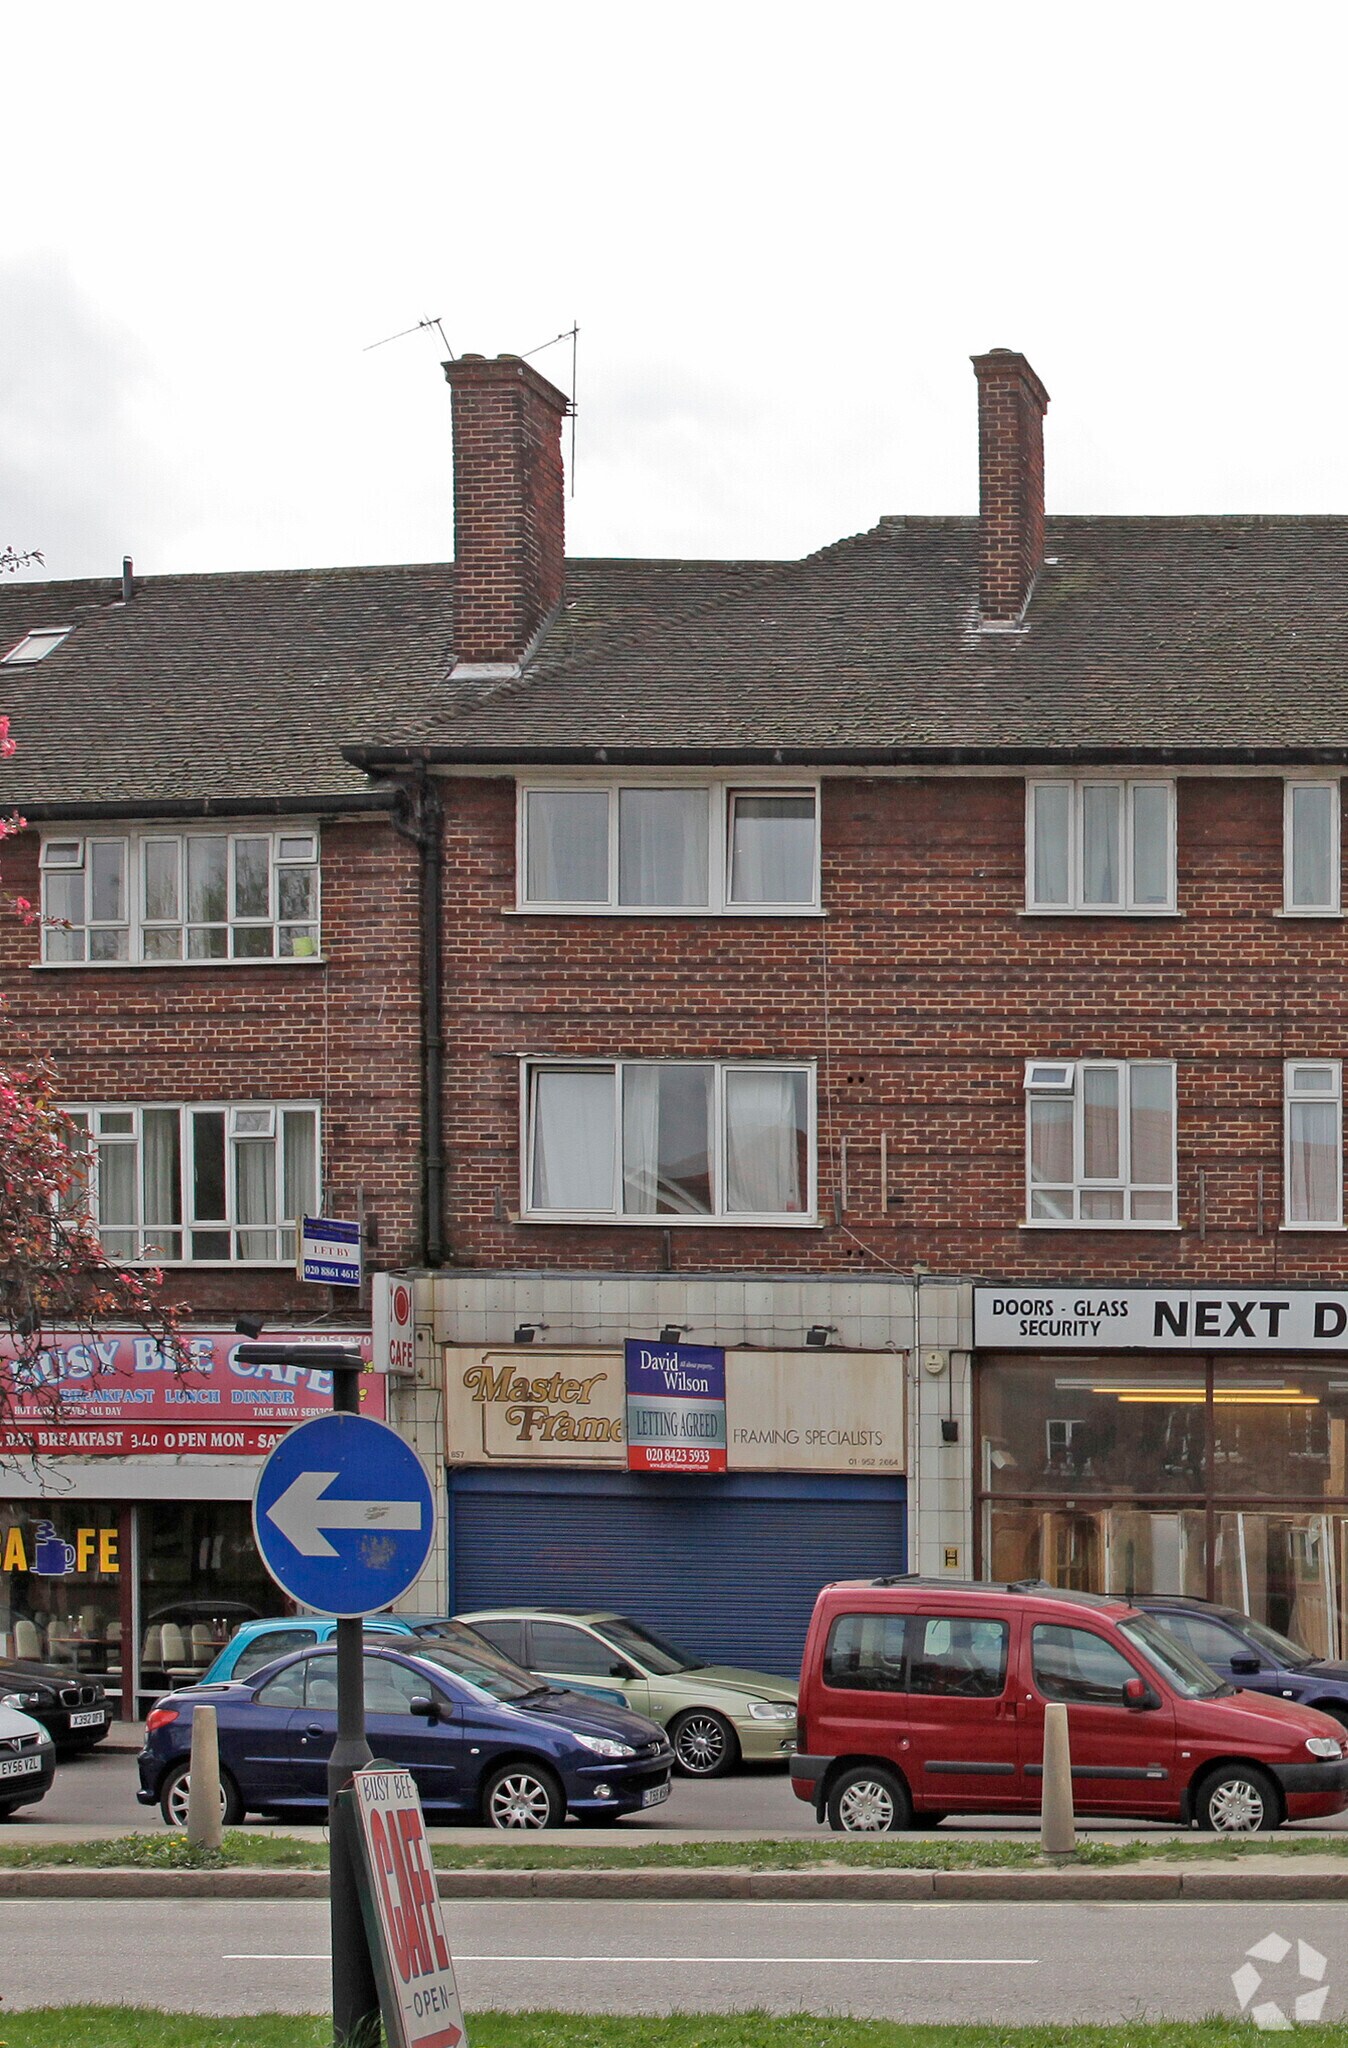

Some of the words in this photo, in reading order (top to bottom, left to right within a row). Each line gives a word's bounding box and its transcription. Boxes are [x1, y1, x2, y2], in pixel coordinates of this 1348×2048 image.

[313, 1245, 334, 1256] LET
[337, 1248, 350, 1257] BY
[305, 1265, 319, 1275] 020
[320, 1267, 338, 1277] 8861
[341, 1269, 359, 1280] 4615
[992, 1299, 1054, 1316] DOORS
[1073, 1300, 1129, 1317] GLASS
[1019, 1320, 1101, 1337] SECURITY
[1153, 1301, 1290, 1338] NEXT
[1313, 1302, 1347, 1338] D
[640, 1350, 679, 1371] David
[463, 1365, 608, 1404] Master
[663, 1371, 709, 1392] Wilson
[59, 1388, 156, 1404] BREAKFAST
[164, 1388, 221, 1404] LUNCH
[231, 1389, 295, 1405] DINNER
[90, 1406, 103, 1416] ALL
[105, 1406, 122, 1416] DAY
[253, 1407, 274, 1417] TAKE
[276, 1407, 299, 1417] AWAY
[637, 1411, 678, 1437] LETTING
[680, 1412, 718, 1438] AGREED
[38, 1431, 124, 1447] BREAKFAST
[210, 1432, 245, 1448] MON
[733, 1428, 800, 1445] FRAMING
[805, 1429, 883, 1446] SPECIALISTS
[646, 1448, 663, 1461] 020
[664, 1449, 687, 1462] 8423
[688, 1450, 710, 1463] 5933
[2, 1760, 22, 1775] EY56
[25, 1757, 38, 1770] VZL
[362, 1775, 389, 1802] BUSY
[394, 1775, 413, 1799] BEE
[370, 1808, 450, 1984] CAFE
